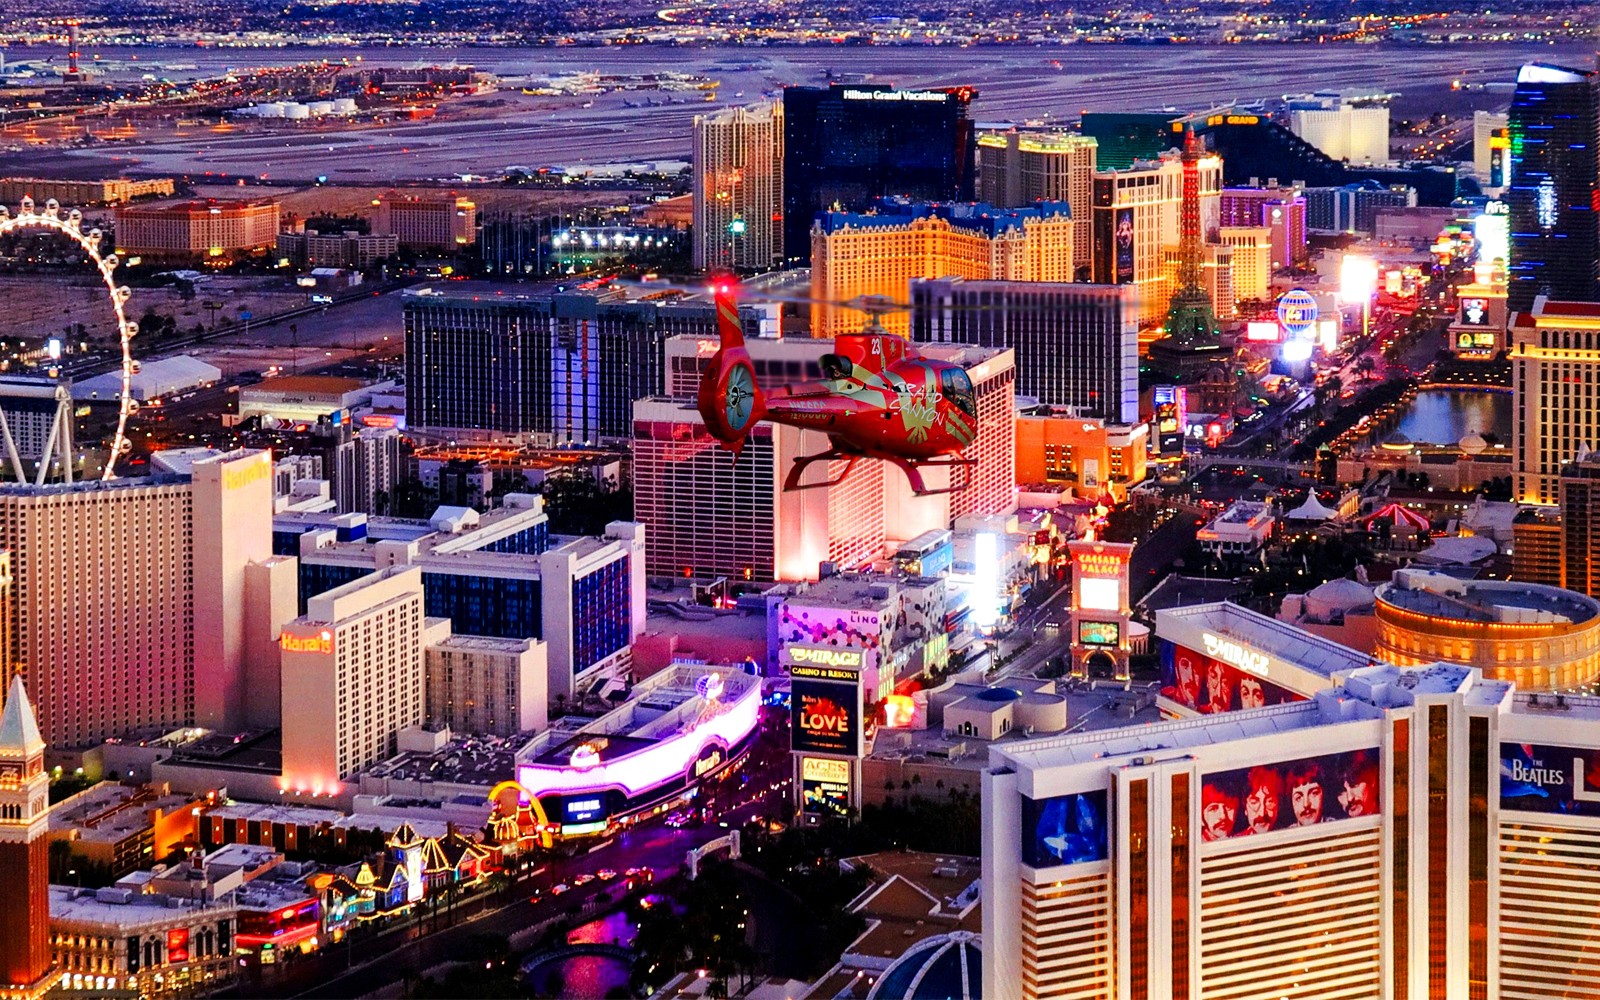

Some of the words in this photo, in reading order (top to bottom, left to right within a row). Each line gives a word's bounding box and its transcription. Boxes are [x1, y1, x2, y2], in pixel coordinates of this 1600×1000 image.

[843, 90, 873, 99] Hilton
[873, 90, 901, 100] Grand
[902, 91, 947, 101] Vacations
[871, 338, 881, 355] 23
[891, 381, 943, 404] GRAND
[889, 400, 945, 426] CANYON
[1079, 554, 1120, 564] CAESARS
[1081, 564, 1119, 574] PALACE
[850, 615, 878, 624] LINQ
[799, 649, 860, 666] MIRAGE
[1207, 639, 1269, 676] MIRAGE
[792, 667, 820, 676] CASINO
[828, 670, 857, 679] RESORT
[801, 712, 849, 732] LOVE
[806, 761, 846, 772] ACES
[1532, 759, 1543, 767] THE
